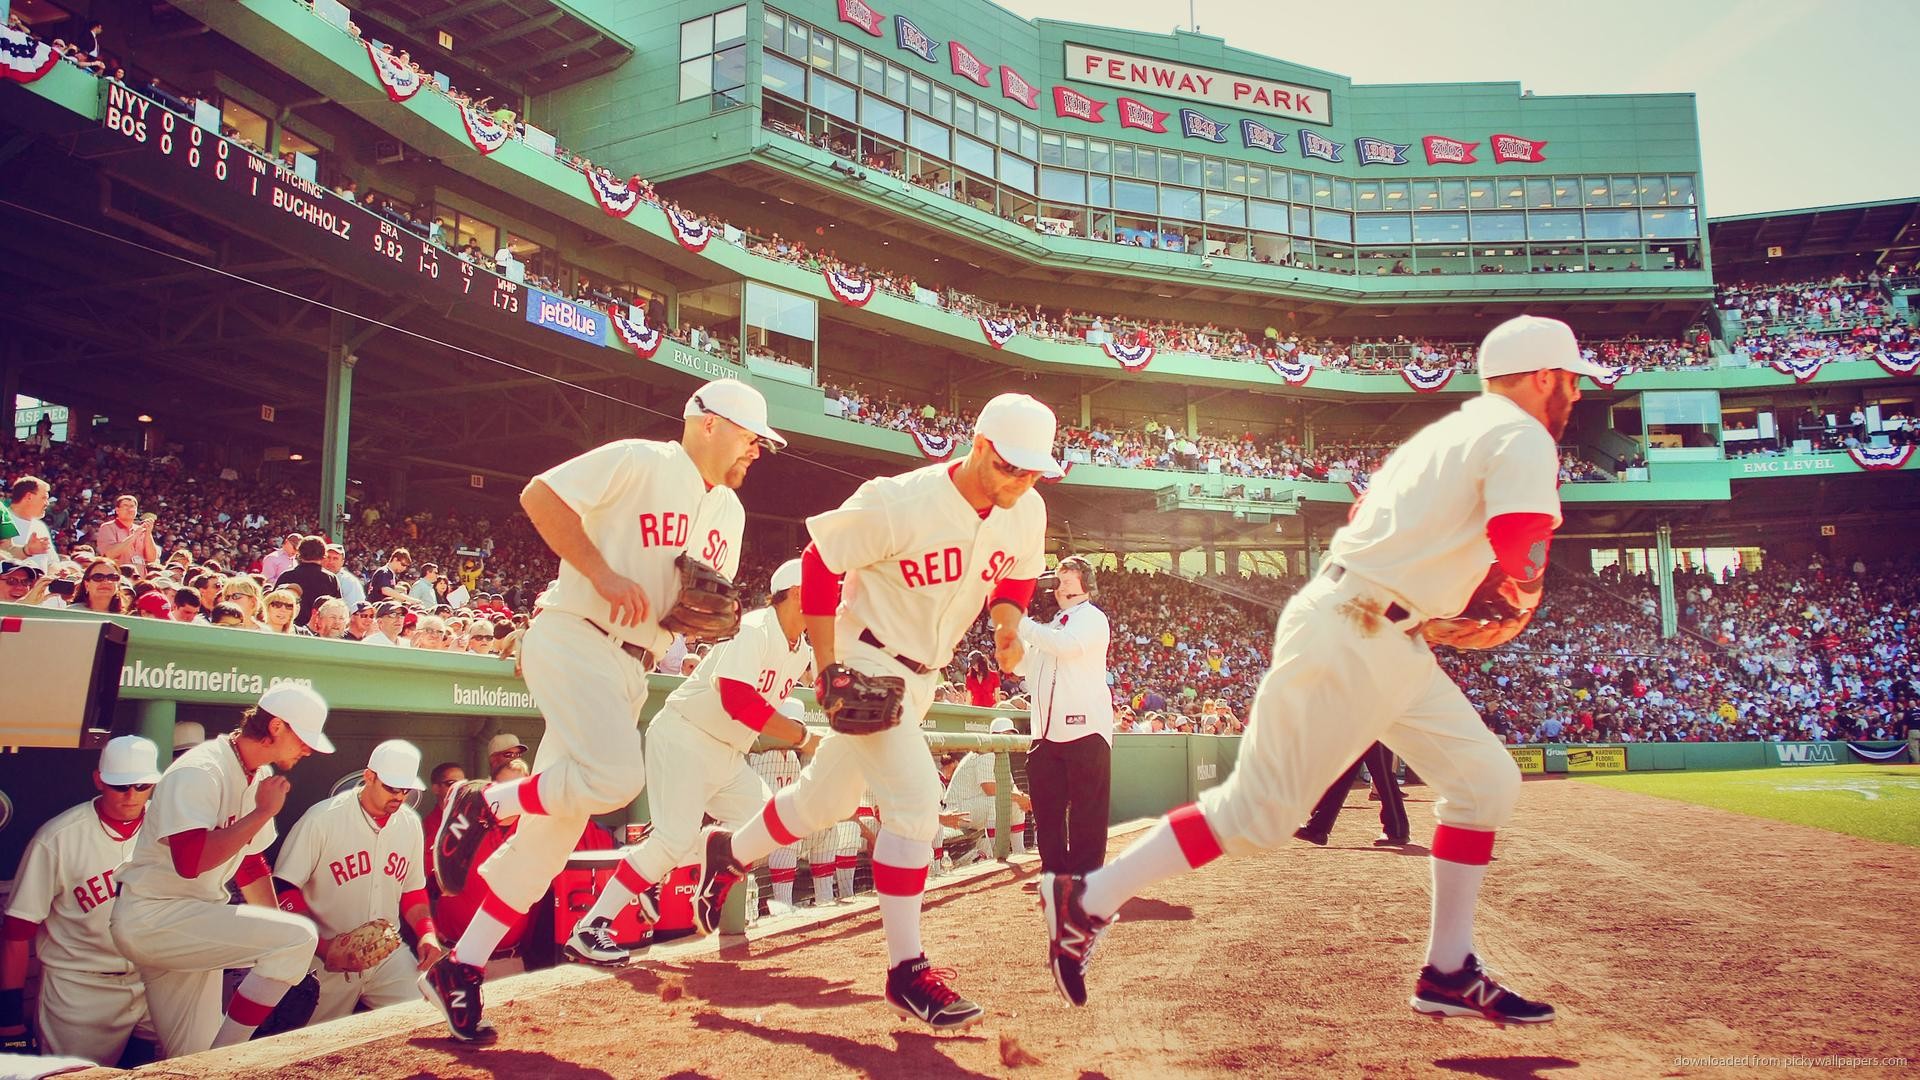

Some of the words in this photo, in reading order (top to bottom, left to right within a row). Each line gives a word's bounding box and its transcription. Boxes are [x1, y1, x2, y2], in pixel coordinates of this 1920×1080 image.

[1086, 55, 1213, 95] FENWAY
[1233, 82, 1313, 113] PARK
[109, 85, 149, 119] NYY
[164, 112, 174, 133] 0
[192, 126, 202, 146] 0
[219, 140, 229, 160] 0
[107, 107, 147, 142] BOS
[161, 134, 172, 155] 0
[189, 147, 200, 167] 0
[216, 161, 227, 180] 0
[1432, 142, 1464, 158] 2004
[1498, 141, 1532, 158] 2007
[249, 155, 266, 175] INN
[275, 167, 323, 200] PITCHING:
[380, 221, 398, 240] ERA
[422, 242, 438, 260] W-L
[497, 278, 517, 293] WHIP
[272, 187, 352, 240] BUCHHOLZ
[374, 235, 403, 262] 9.82
[419, 256, 439, 279] 1-0
[463, 278, 471, 294] 7
[492, 291, 518, 313] 1.73
[538, 297, 596, 337] jetBlue
[674, 350, 701, 370] EMC
[1744, 462, 1778, 473] EMC
[1783, 459, 1834, 471] LEVEL
[640, 512, 688, 547] RED
[702, 529, 728, 571] SO
[1823, 527, 1833, 535] 24
[900, 547, 962, 588] RED
[1776, 744, 1836, 761] WM
[329, 850, 371, 887] RED
